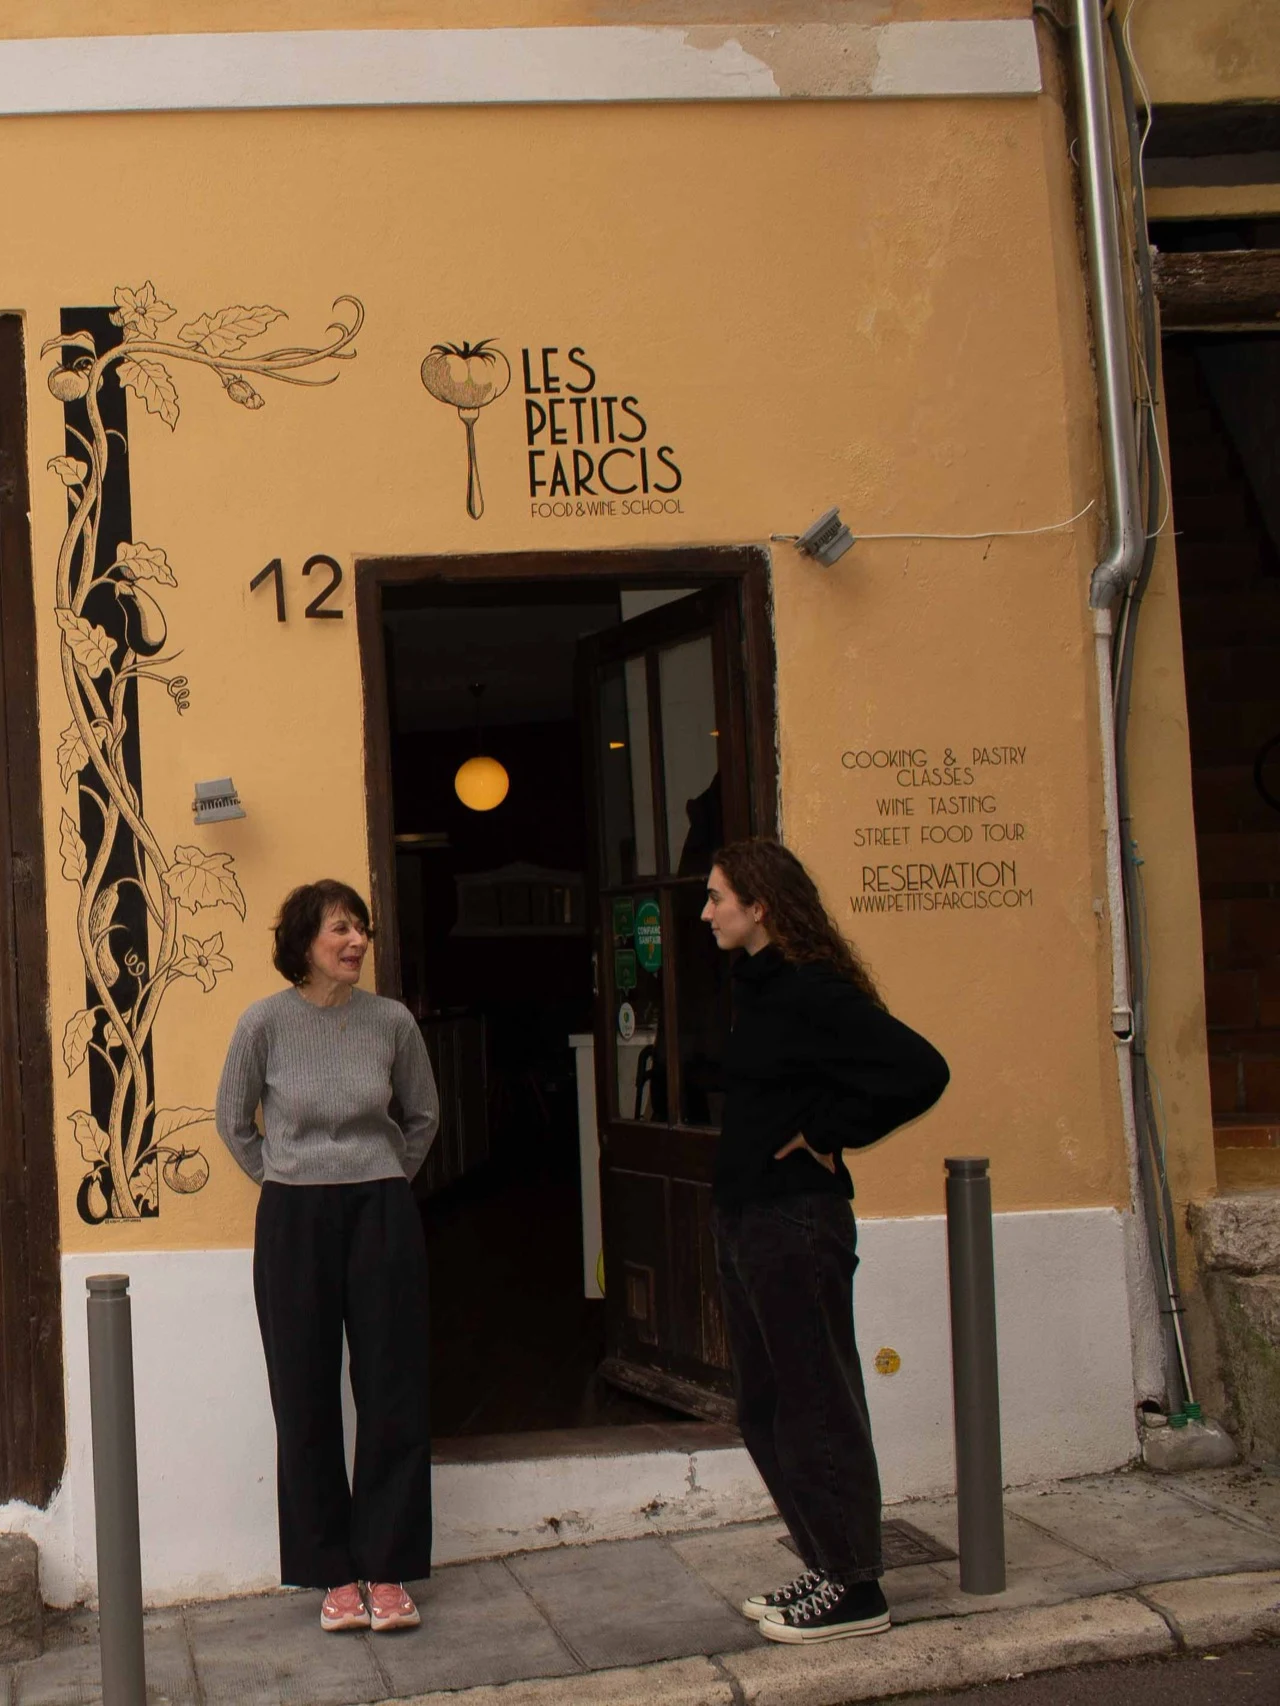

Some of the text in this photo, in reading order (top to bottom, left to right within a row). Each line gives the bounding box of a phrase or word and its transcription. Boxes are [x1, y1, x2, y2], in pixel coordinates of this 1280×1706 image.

[521, 346, 596, 394] LES
[525, 396, 647, 446] PETITS
[528, 446, 683, 498] FARCIS
[621, 499, 685, 515] SCHOOL
[249, 554, 344, 623] 12
[841, 746, 1027, 769] COOKING & PASTRY
[896, 767, 975, 787] CLASSES
[876, 795, 997, 816] WINE TASTING
[853, 823, 1025, 847] STREET FOOD TOUR
[862, 860, 1017, 892] RESERVATION
[850, 888, 1033, 913] WWW.PETITSFARCIS.COM
[637, 926, 661, 936] CONFIANC
